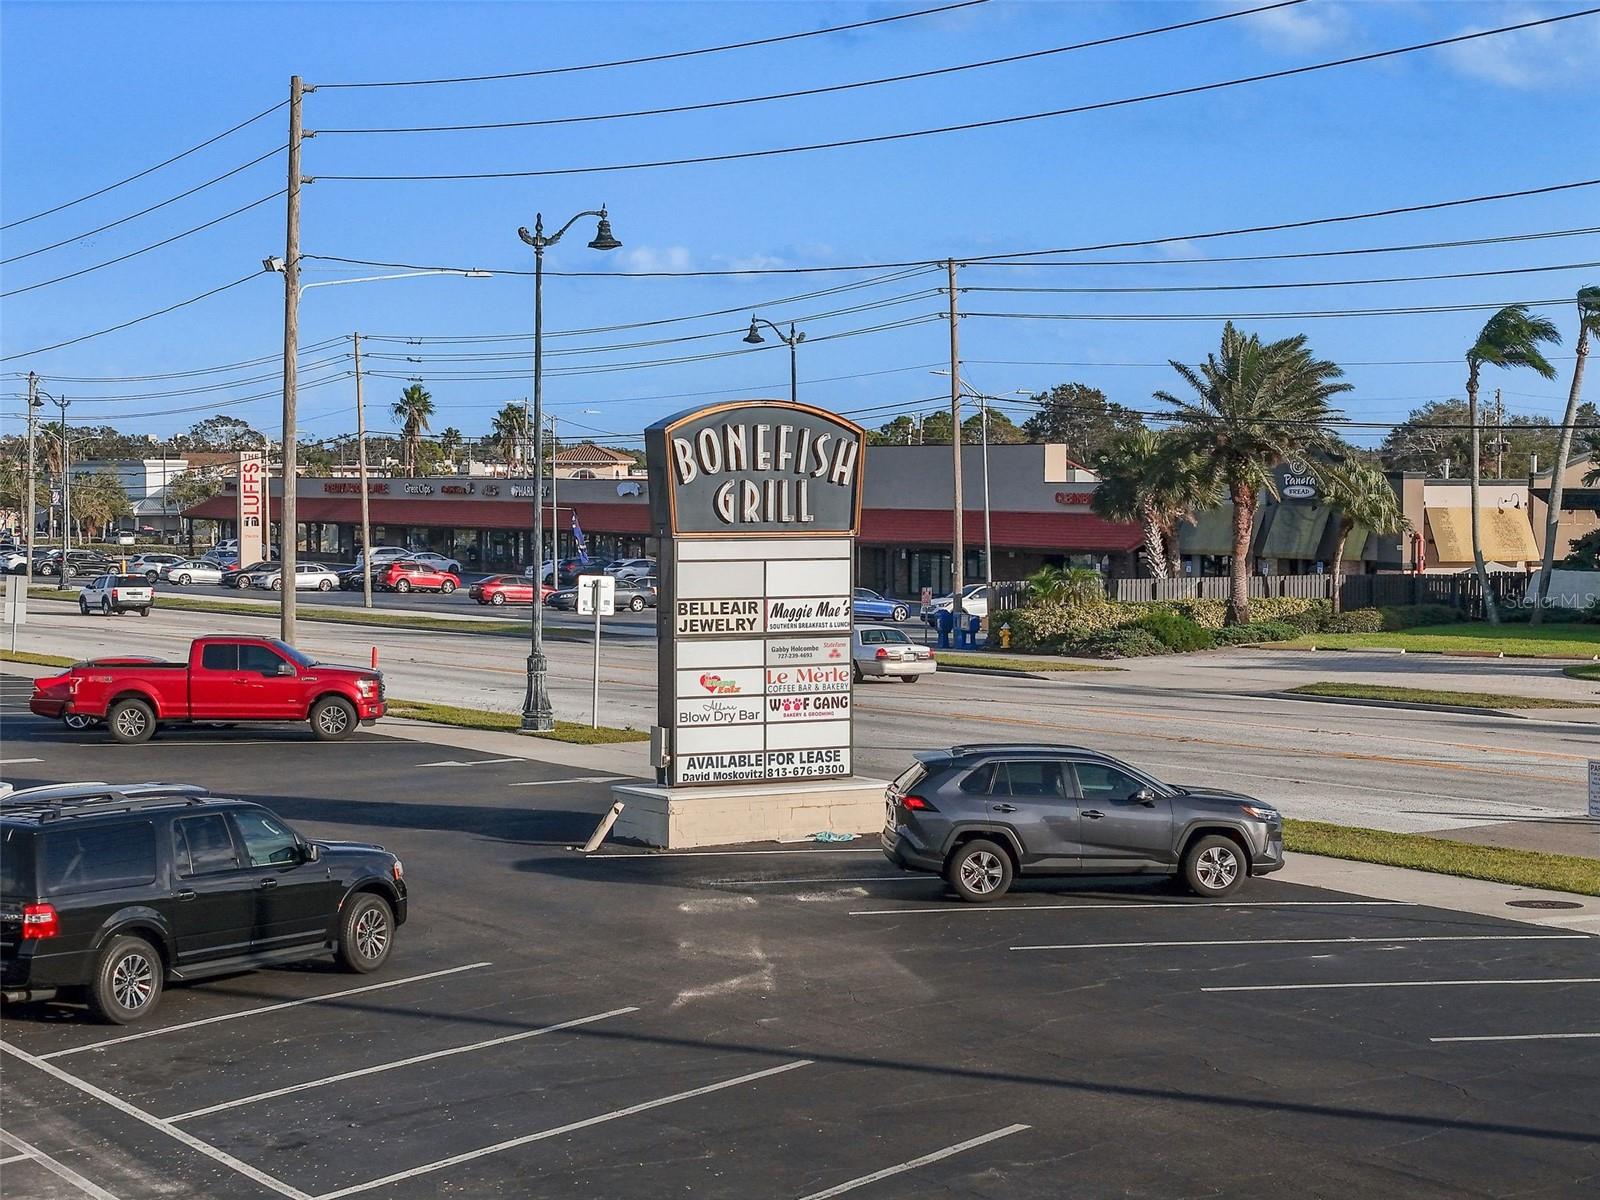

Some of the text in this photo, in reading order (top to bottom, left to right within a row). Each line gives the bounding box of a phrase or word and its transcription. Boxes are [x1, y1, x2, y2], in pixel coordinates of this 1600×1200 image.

[243, 453, 260, 461] THE
[672, 423, 859, 486] BONEFISH
[1283, 473, 1316, 486] Panera
[713, 478, 815, 525] GRILL
[677, 601, 759, 616] BELLEAIR
[769, 600, 850, 622] Maggie Mae's
[678, 617, 758, 632] JEWELRY
[767, 667, 850, 684] Le Mèrle
[767, 682, 849, 693] COFFEE BAR & BAKERY
[813, 695, 849, 710] GANG
[679, 709, 760, 723] Blow Dry Bar
[686, 750, 841, 770] AVAILABLE FOR LEASE
[682, 764, 845, 782] David Moskovitz 813-676-9300
